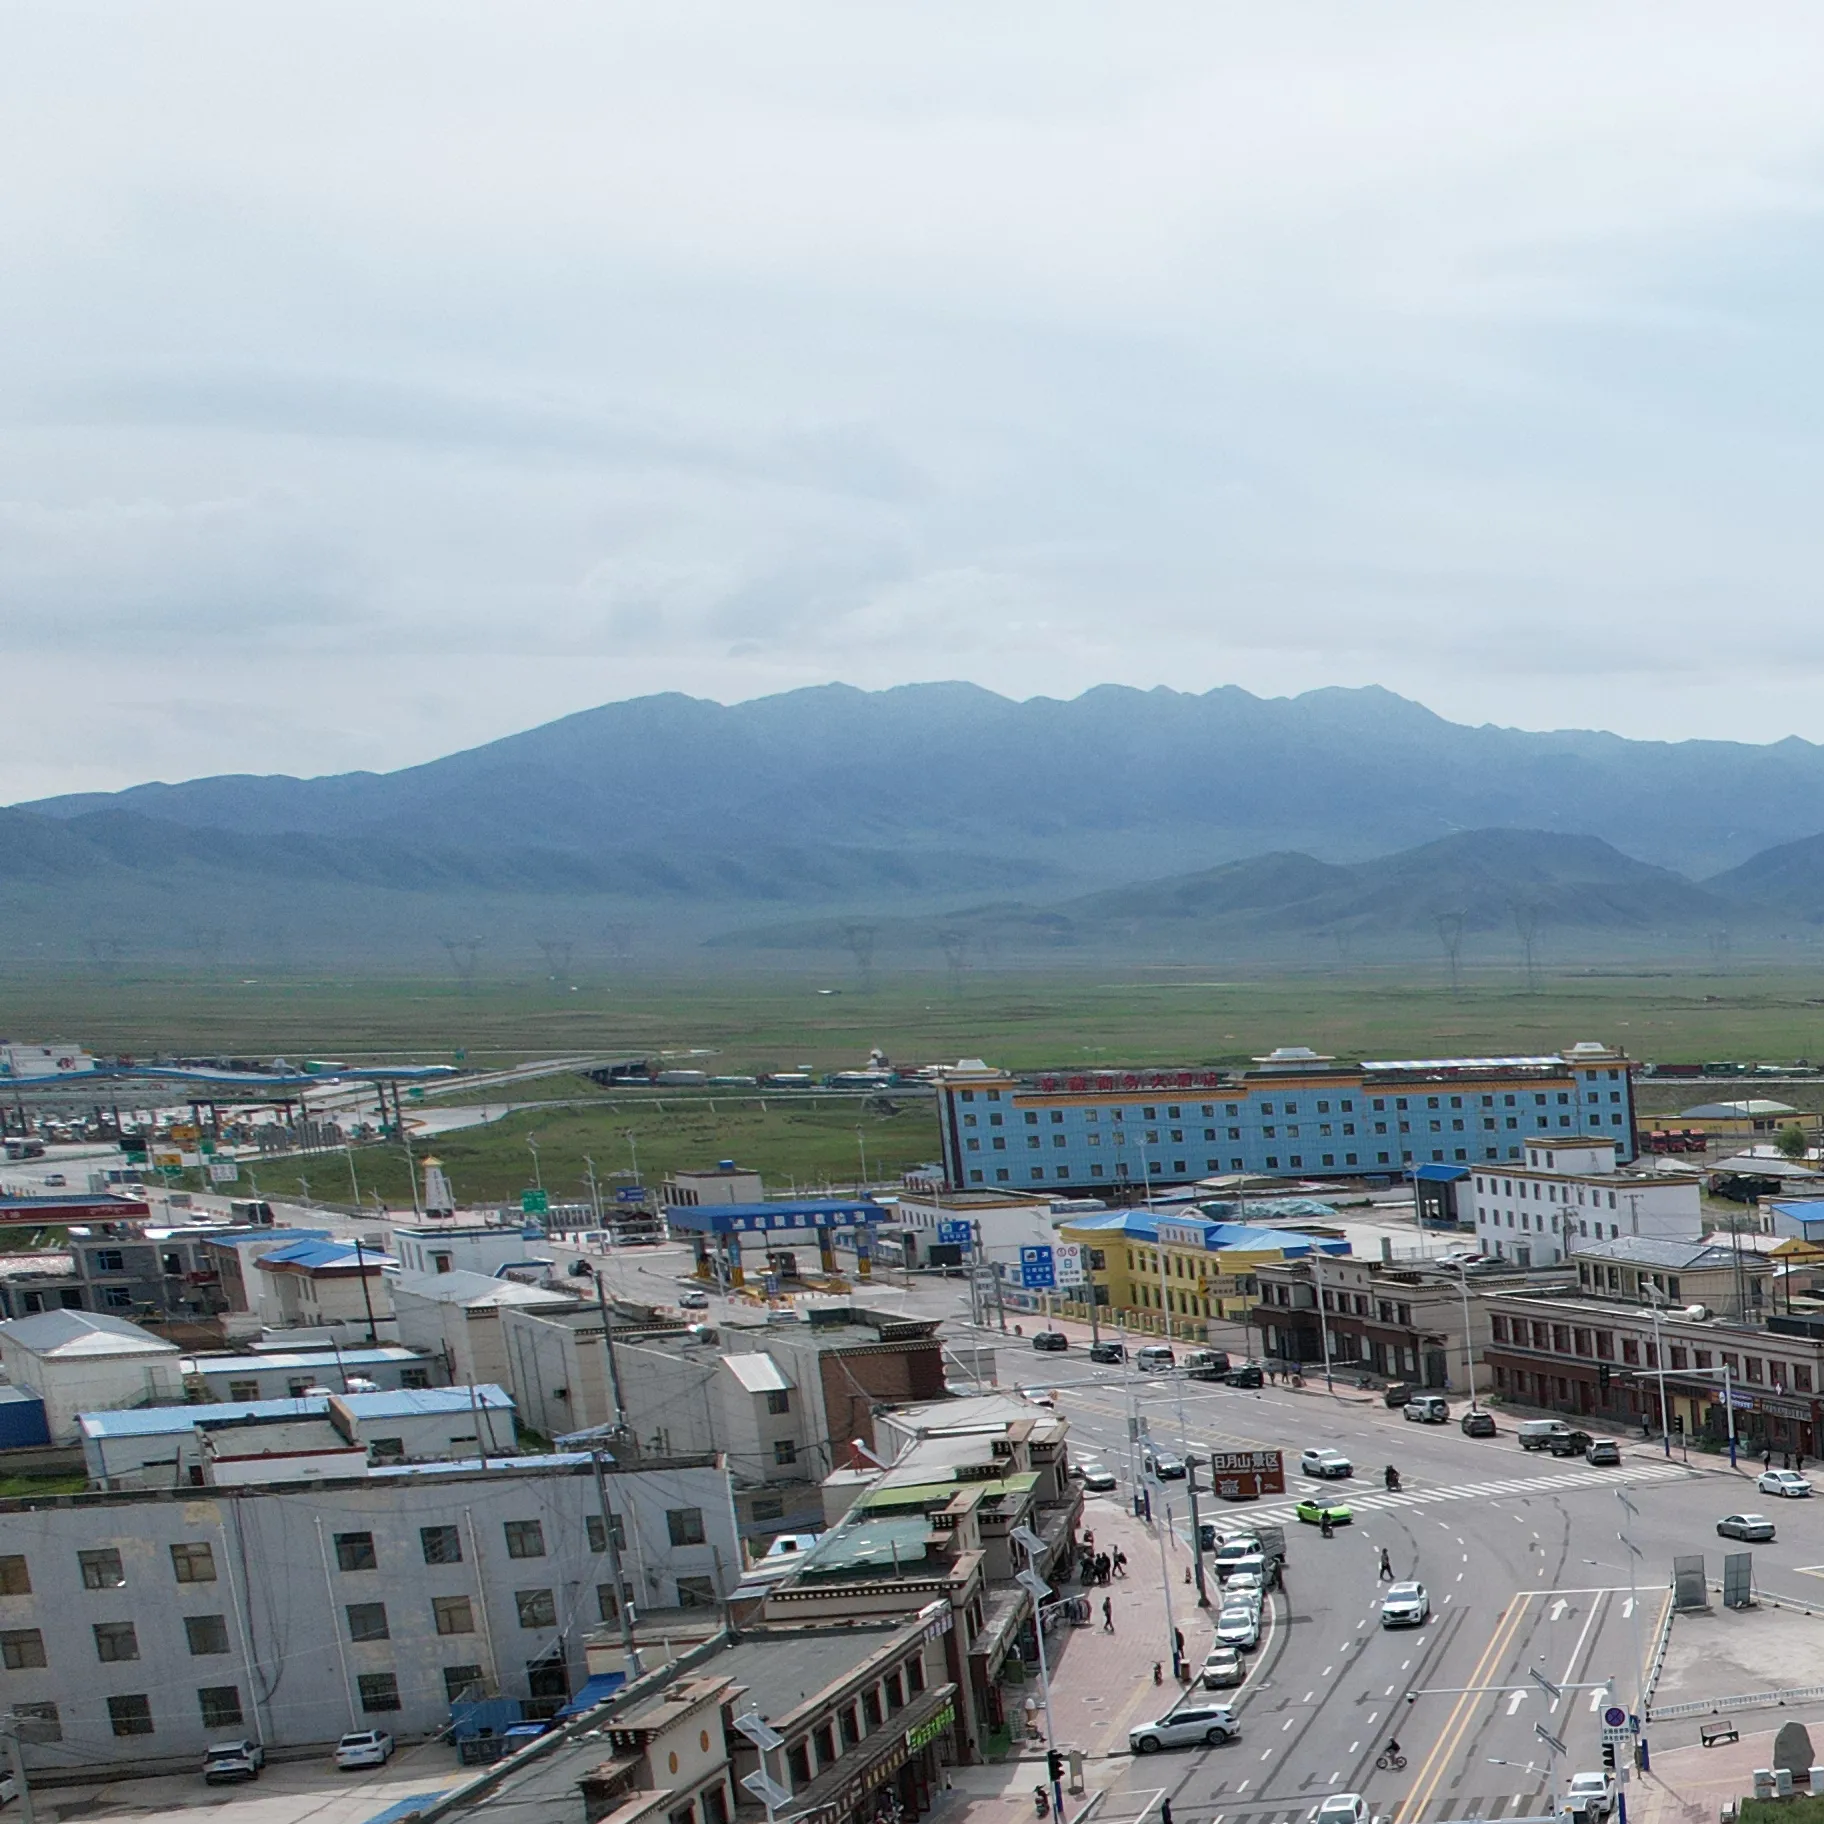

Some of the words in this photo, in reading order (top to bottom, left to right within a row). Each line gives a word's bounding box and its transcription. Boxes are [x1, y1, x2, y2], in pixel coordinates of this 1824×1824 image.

[1215, 1453, 1278, 1469] 日月山景区
